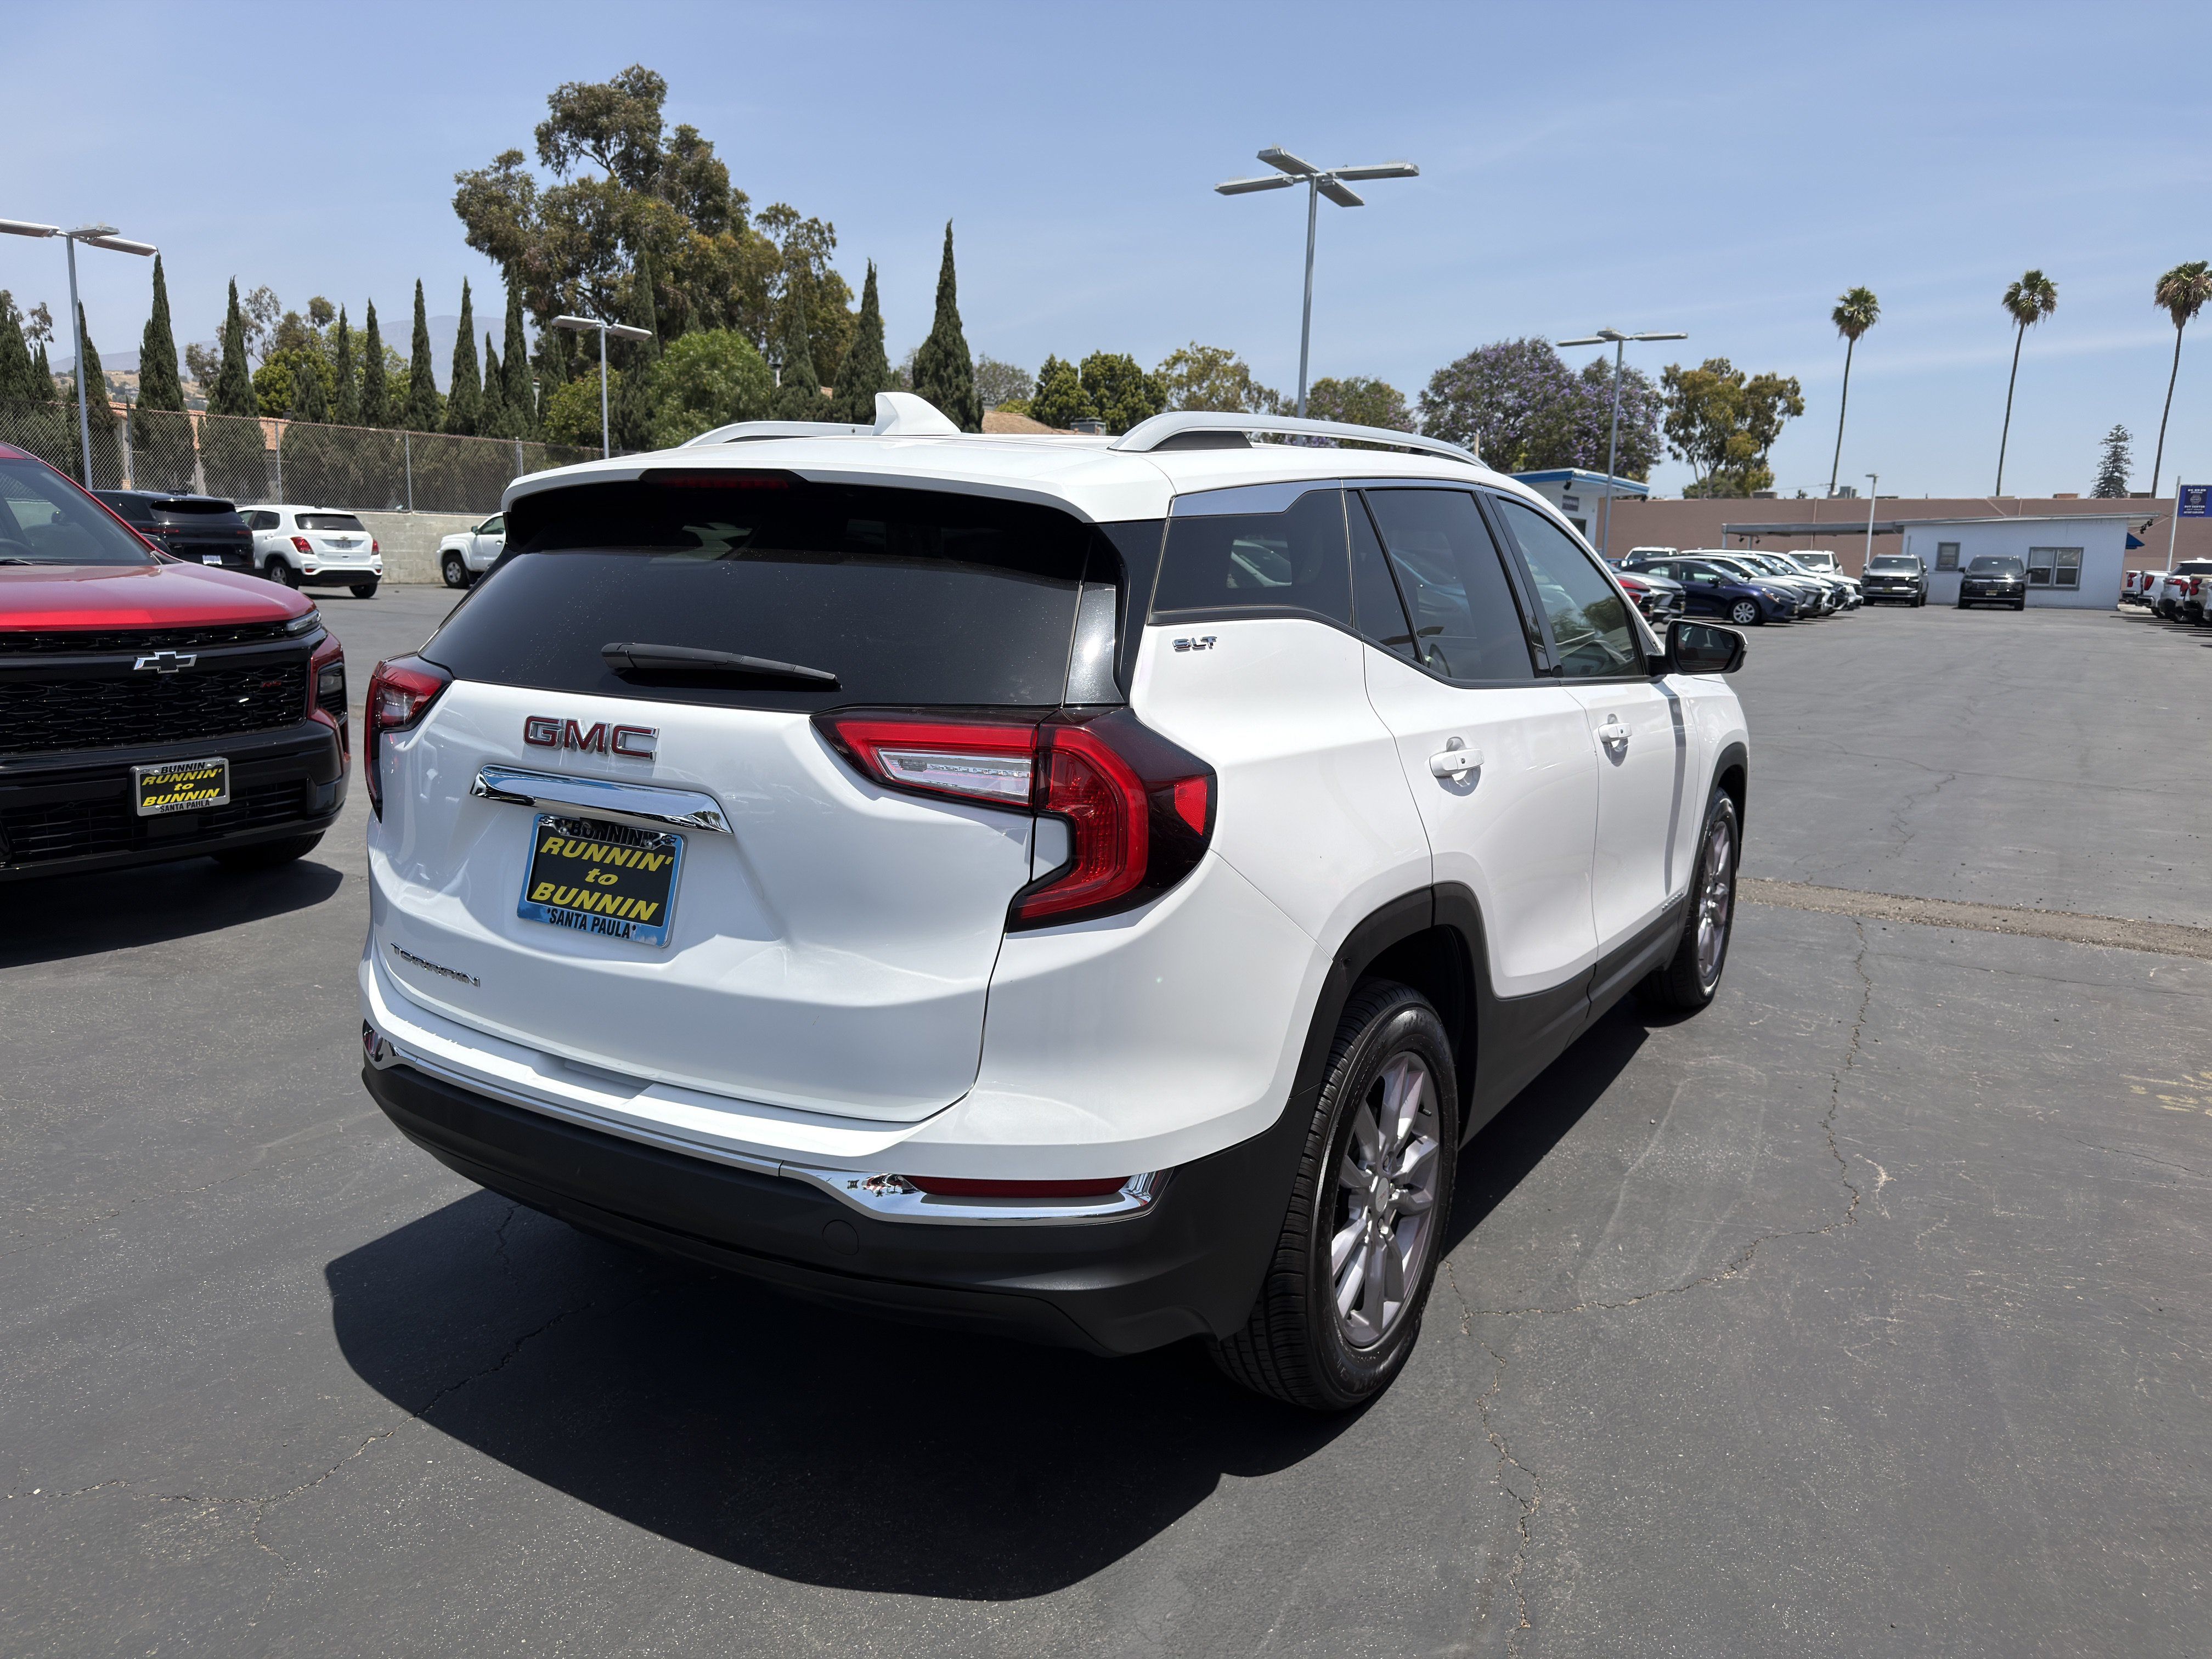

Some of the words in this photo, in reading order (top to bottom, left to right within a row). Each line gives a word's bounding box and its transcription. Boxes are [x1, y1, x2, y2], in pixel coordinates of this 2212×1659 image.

[1172, 636, 1217, 652] SLT
[523, 715, 659, 761] GMC
[142, 768, 223, 786] RUNNIN'
[161, 762, 205, 774] BUNNIN
[174, 783, 194, 791] to
[142, 788, 220, 806] BUNNIN
[160, 803, 184, 812] SANTA
[187, 799, 210, 809] PAULA
[540, 837, 674, 872] RUNNIN'
[585, 868, 618, 885] to
[531, 882, 659, 921] BUNNIN
[549, 908, 587, 930] SANTA
[590, 916, 631, 939] PAULA
